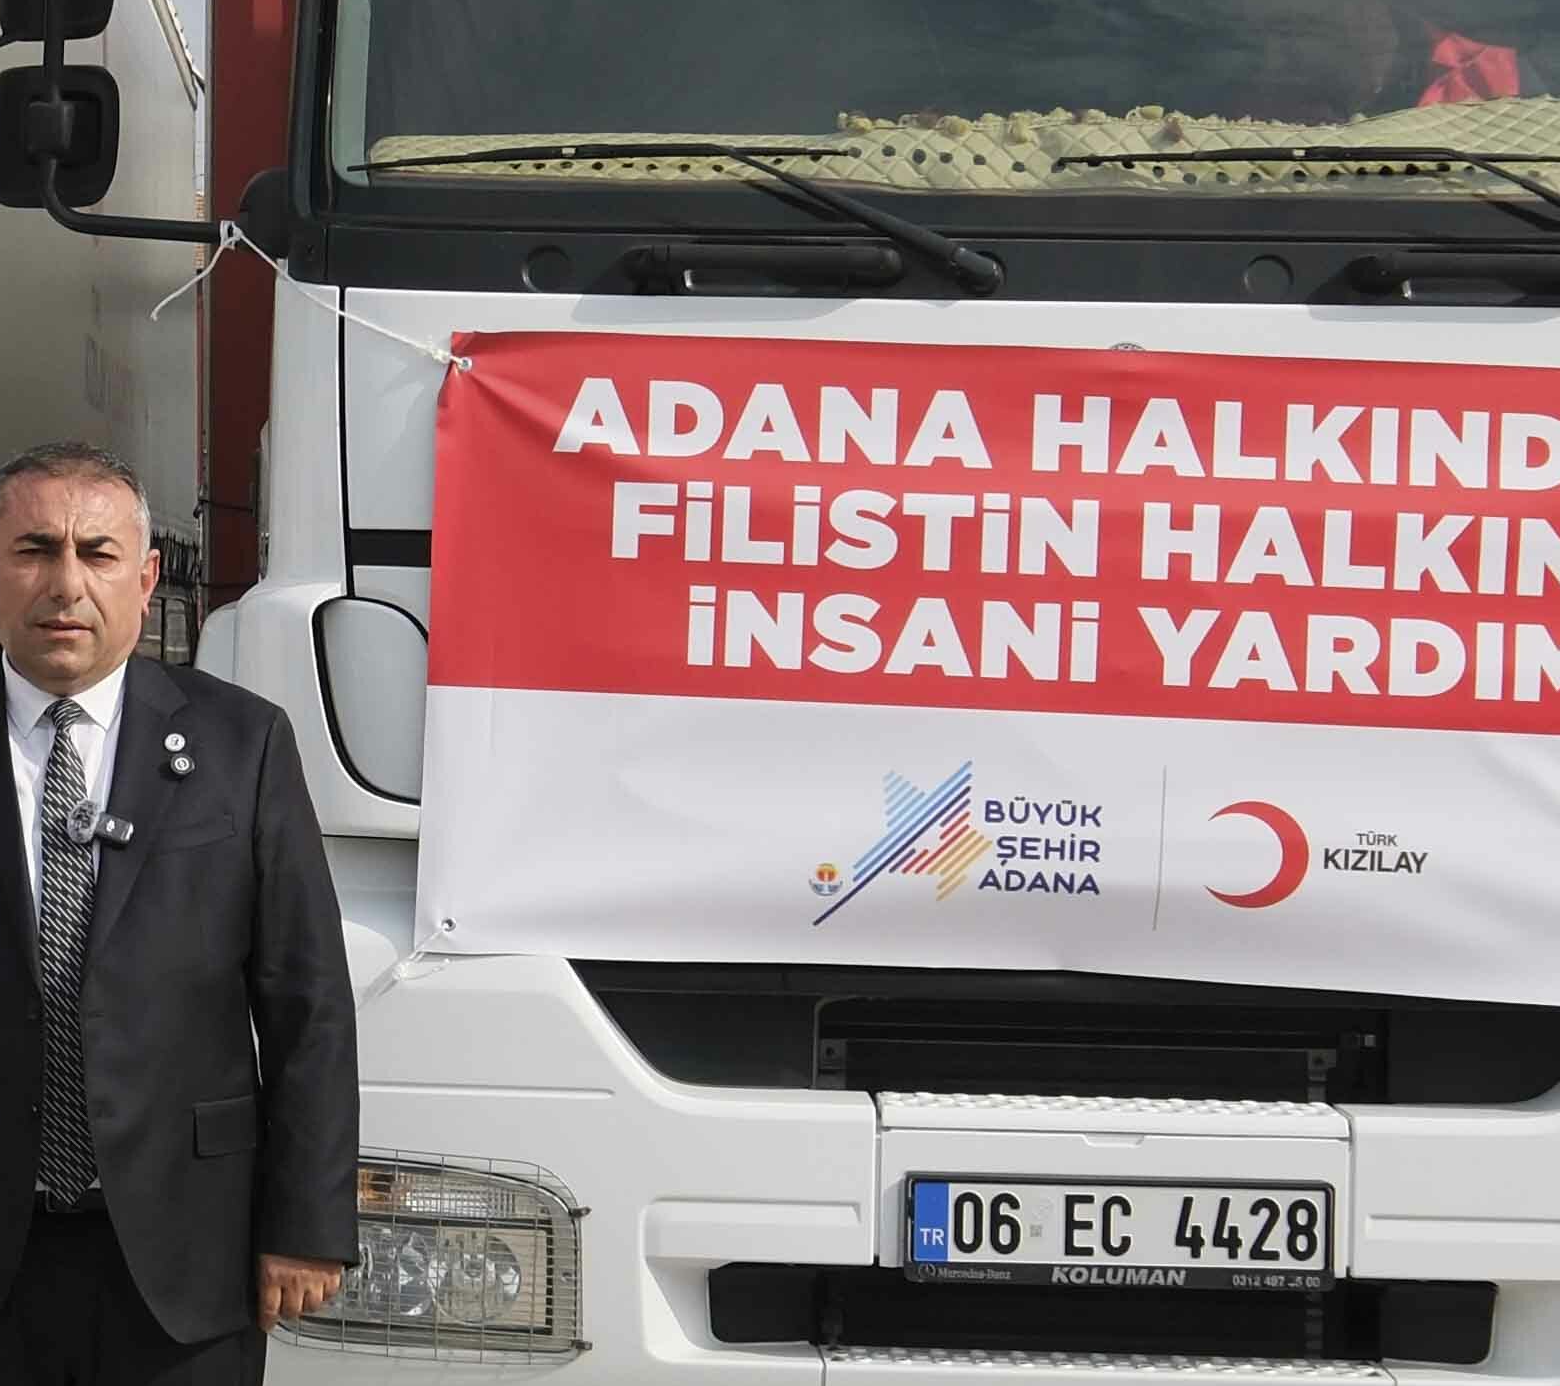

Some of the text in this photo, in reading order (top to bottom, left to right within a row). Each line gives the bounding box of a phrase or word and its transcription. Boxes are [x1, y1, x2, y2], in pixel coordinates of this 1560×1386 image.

[553, 378, 992, 469] ADANA
[984, 796, 1102, 828] BÜYÜK
[996, 834, 1101, 868] ŞEHİR
[1356, 831, 1397, 847] TÜRK
[1323, 848, 1428, 874] KIZILAY
[978, 869, 1101, 896] ADANA
[920, 1227, 945, 1246] TR
[954, 1192, 1318, 1261] 06 EC 4428
[1051, 1266, 1186, 1286] KOLUMAN
